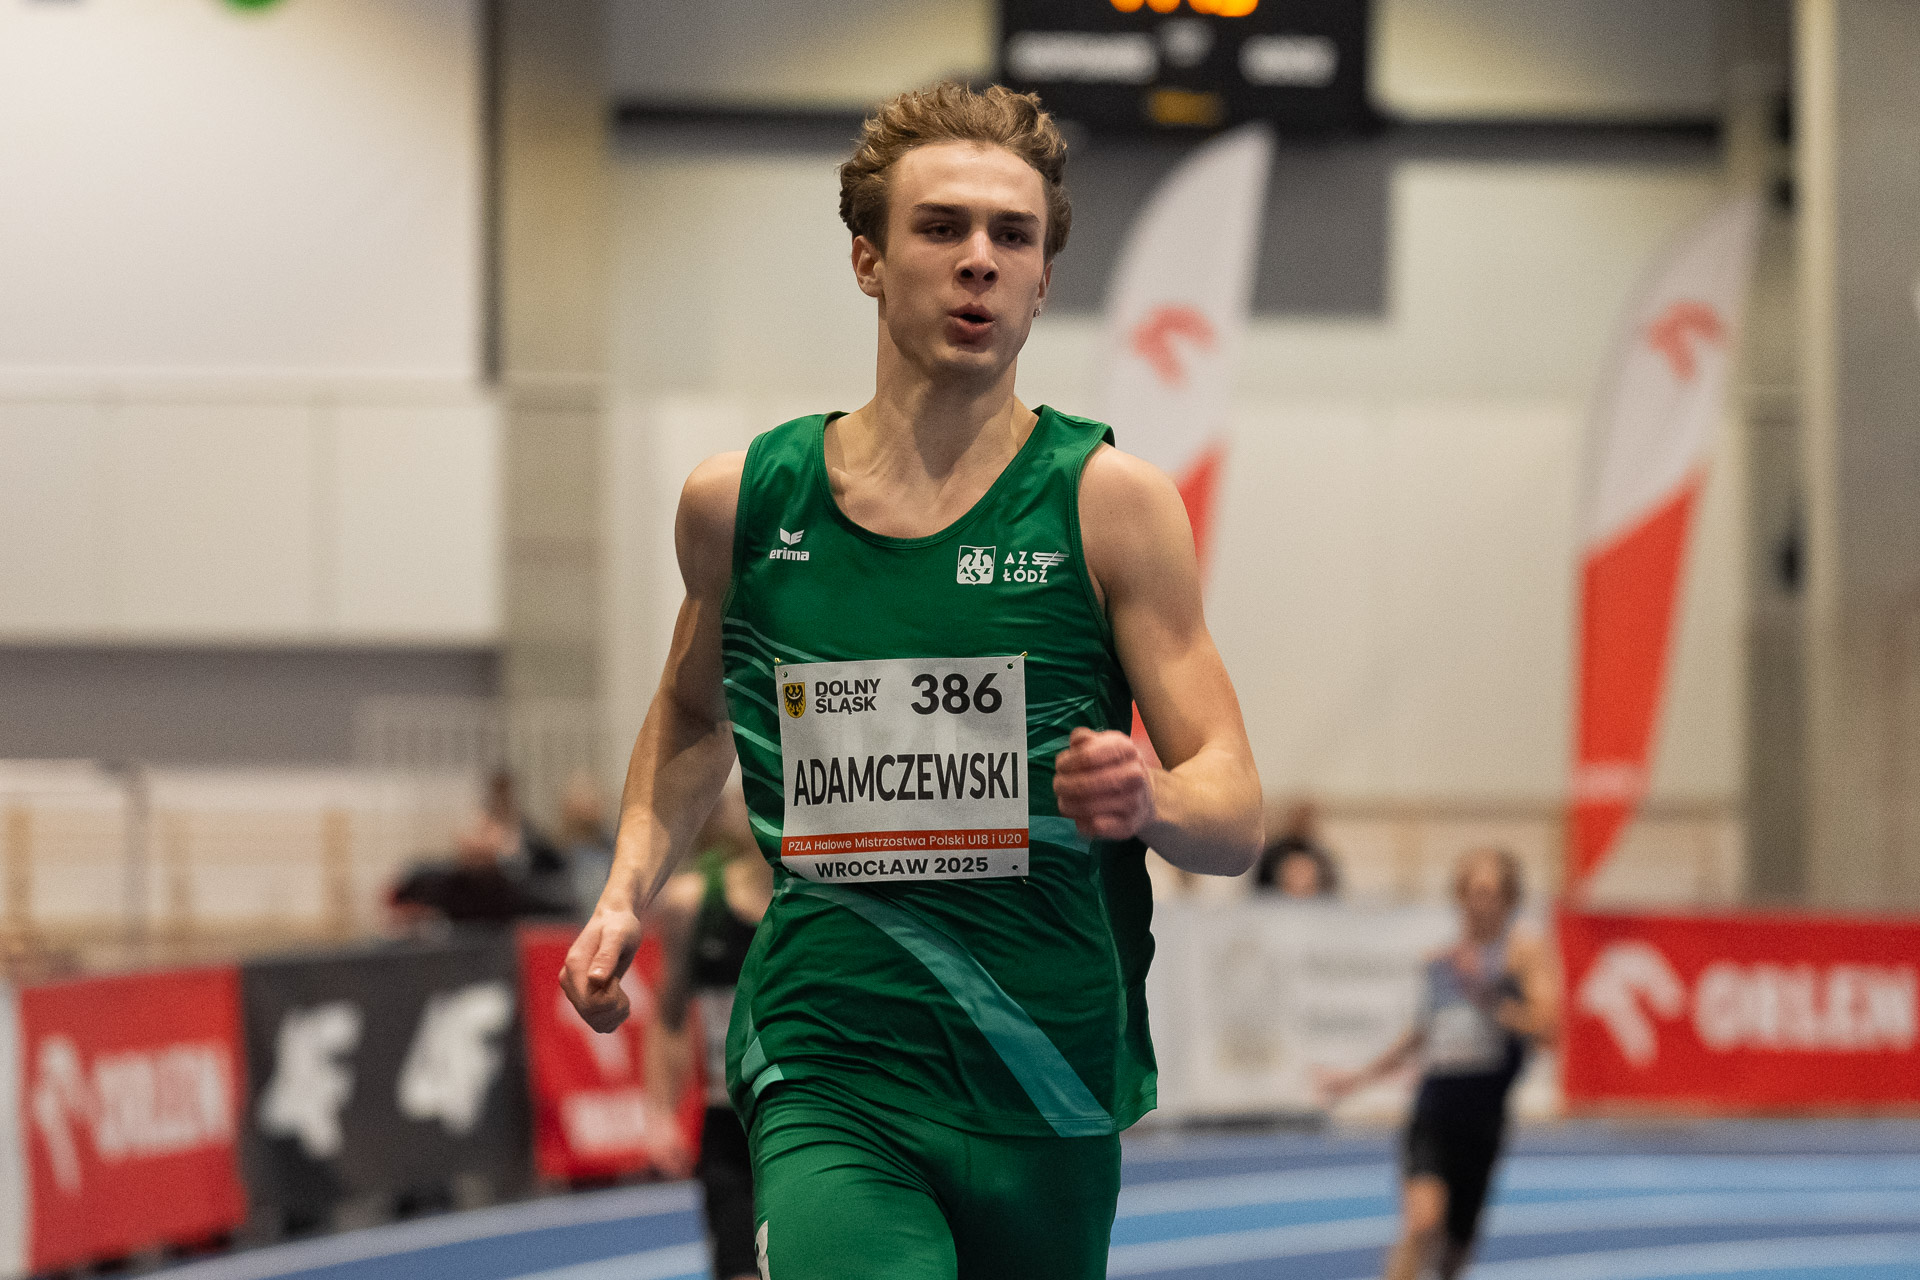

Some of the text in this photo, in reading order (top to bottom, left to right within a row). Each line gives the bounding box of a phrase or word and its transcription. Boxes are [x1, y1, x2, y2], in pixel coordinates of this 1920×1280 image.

[769, 547, 810, 561] erima
[815, 678, 881, 697] DOLNY
[910, 672, 1003, 715] 386
[815, 695, 877, 715] ŚLĄSK
[793, 752, 1019, 807] ADAMCZEWSKI
[788, 841, 812, 852] PZLA
[814, 839, 852, 851] Halowe
[855, 836, 926, 849] Mistrzostwa
[929, 834, 965, 846] Polski
[968, 834, 989, 845] U18
[998, 833, 1022, 844] U20
[815, 856, 989, 878] WROCŁAW 2025
